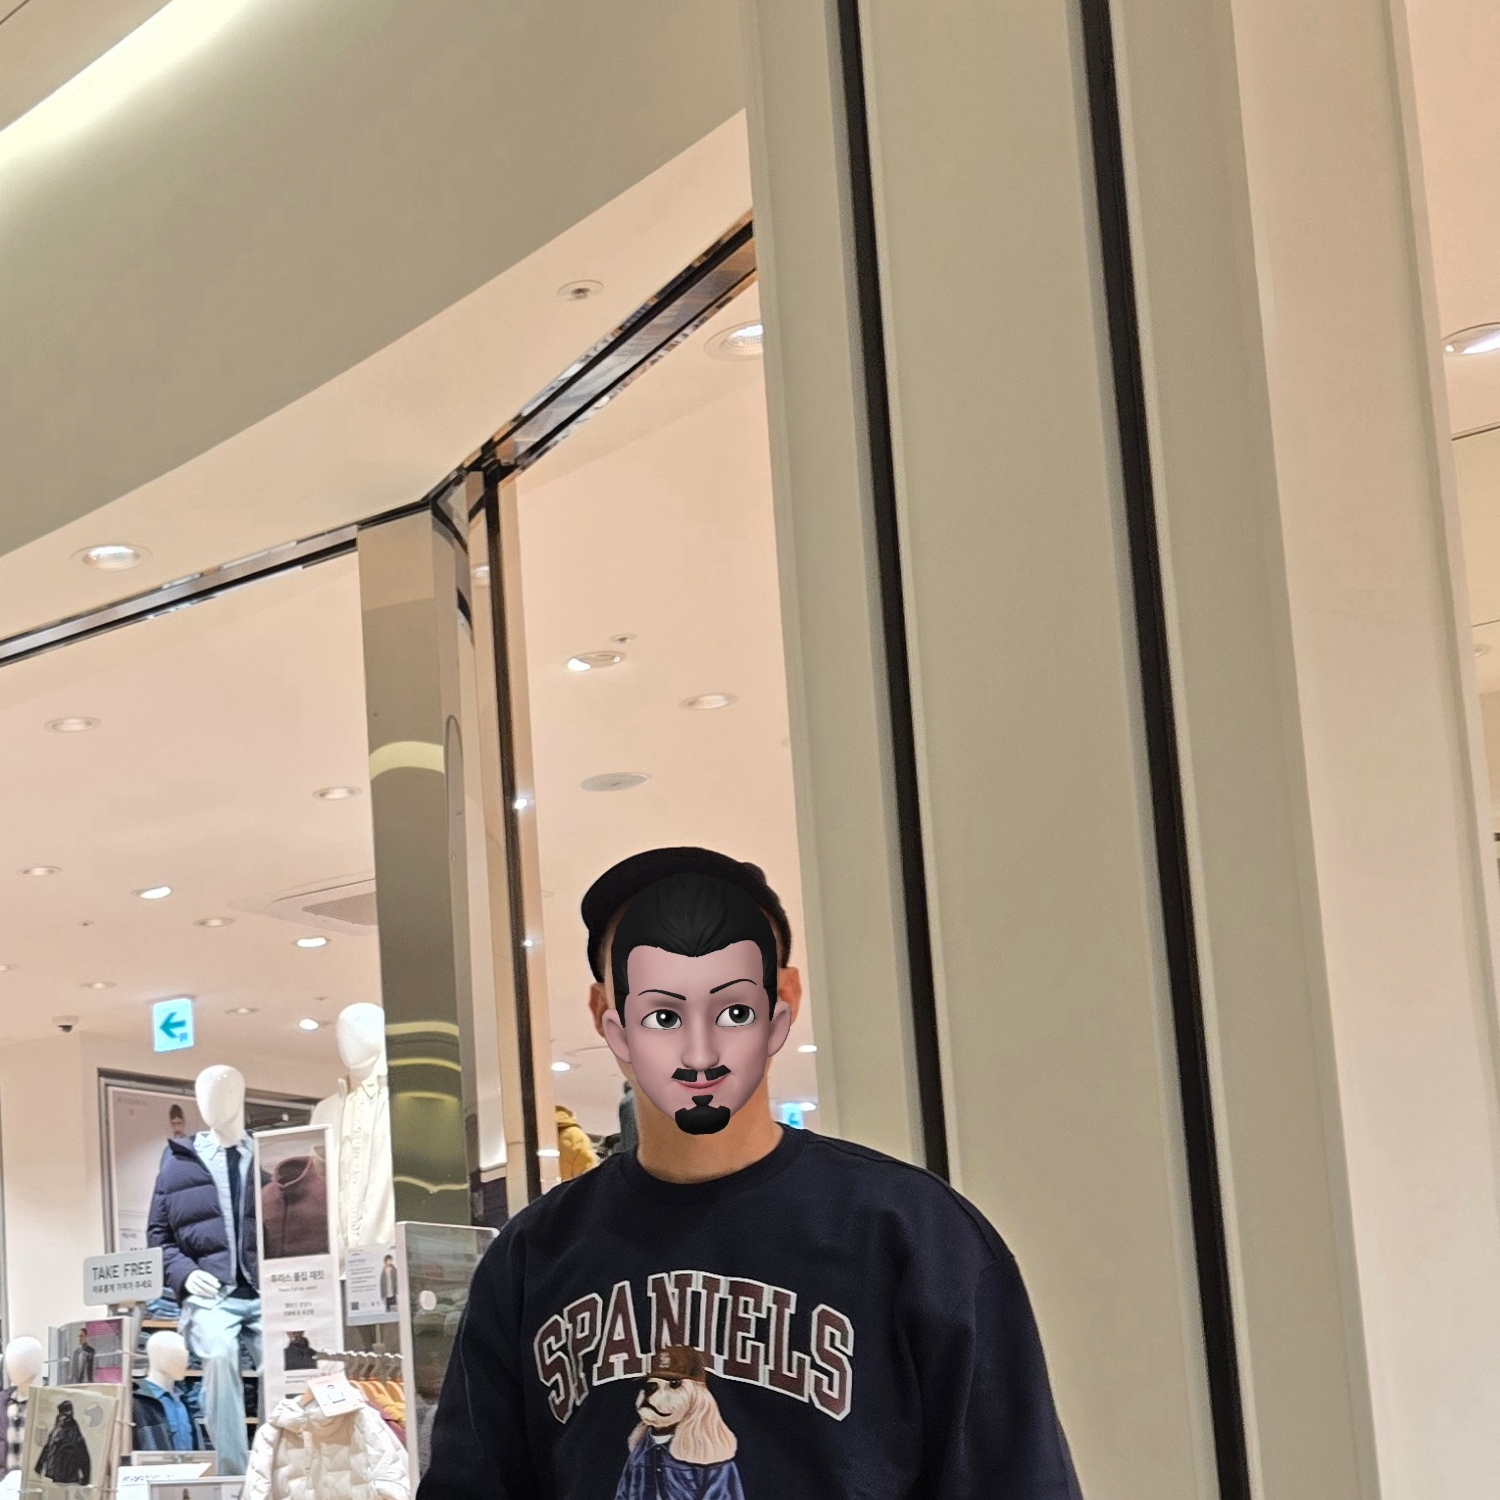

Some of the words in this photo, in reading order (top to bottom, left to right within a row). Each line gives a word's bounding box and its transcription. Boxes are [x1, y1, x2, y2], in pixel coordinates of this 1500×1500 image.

[92, 1264, 119, 1280] TAKE
[123, 1260, 153, 1277] FREE
[270, 1273, 292, 1283] 후리스
[92, 1283, 115, 1294] 자유롭게
[116, 1281, 133, 1291] 가져가
[134, 1279, 152, 1289] 주세요
[533, 1269, 854, 1425] SPANIELS
